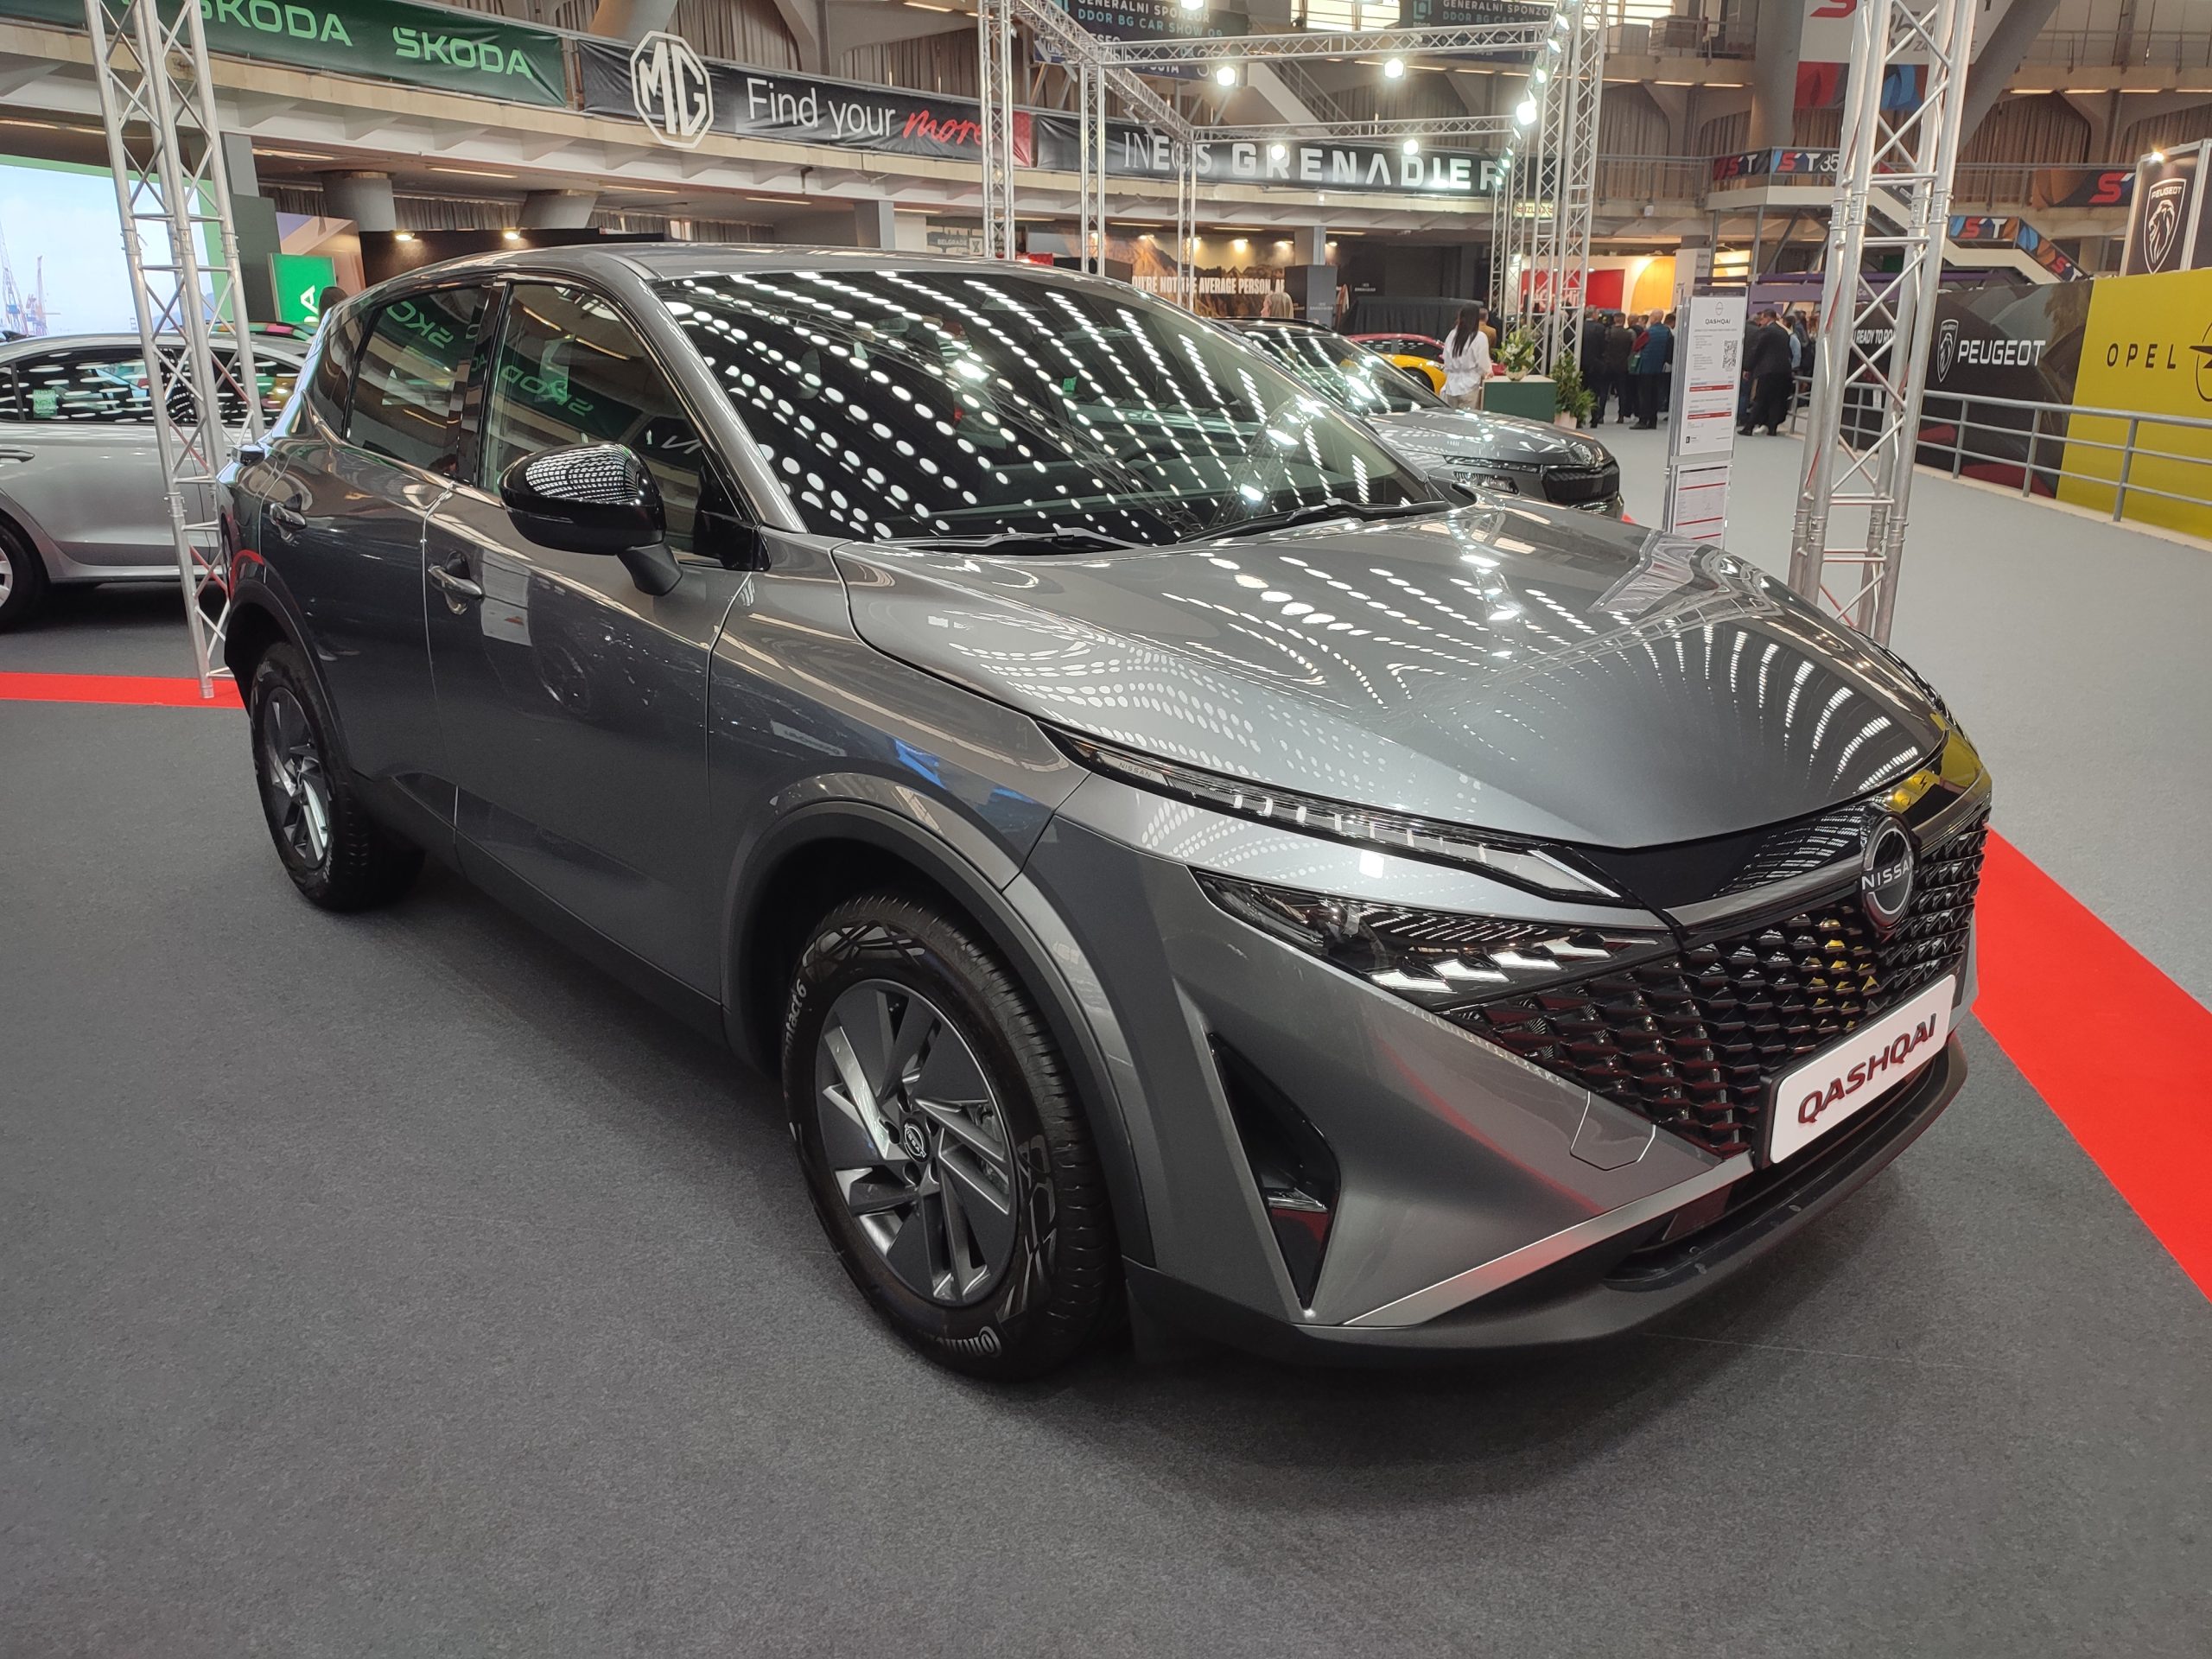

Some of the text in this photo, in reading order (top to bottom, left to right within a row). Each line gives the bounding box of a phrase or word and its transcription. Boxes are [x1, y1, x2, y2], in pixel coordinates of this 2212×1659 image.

[1078, 9, 1113, 24] DDOR
[1118, 16, 1135, 27] BG
[1139, 18, 1164, 31] CAR
[1169, 22, 1203, 37] SHOW
[1443, 10, 1472, 22] DDOR
[1476, 13, 1490, 22] BG
[639, 41, 706, 137] MG
[747, 77, 819, 128] Find
[828, 99, 896, 140] your
[2151, 185, 2183, 199] PEUGEOT
[1198, 276, 1237, 295] AVERAGE
[1957, 340, 2046, 366] PEUGEOT
[2107, 342, 2177, 370] OPEL
[1861, 855, 1915, 891] NISSAN
[1797, 1013, 1937, 1124] QASHQAI
